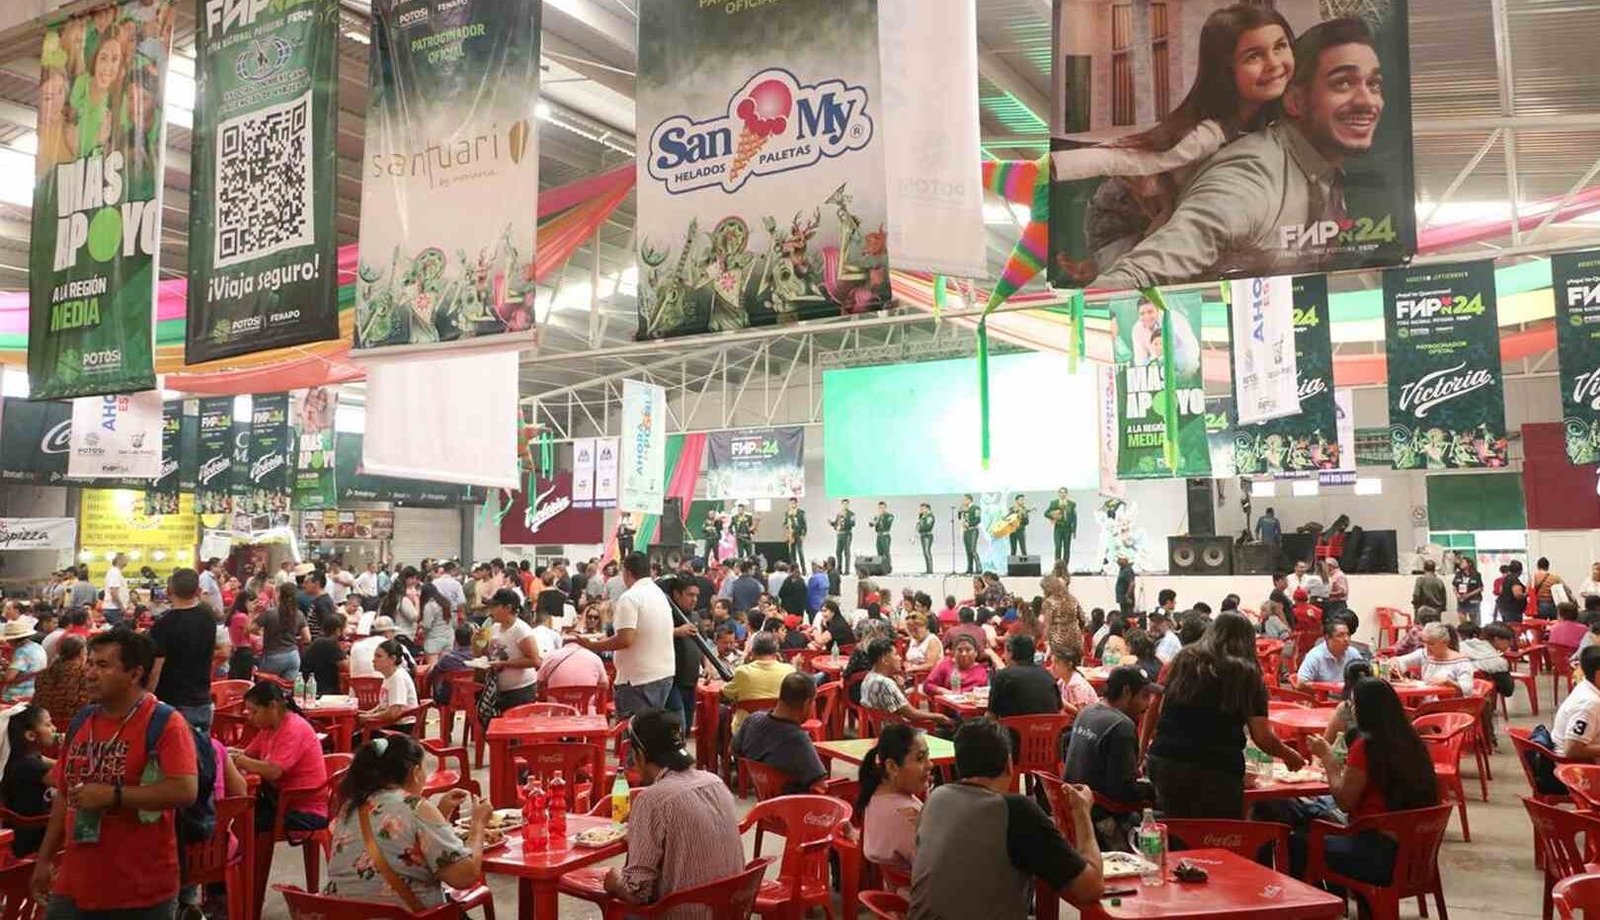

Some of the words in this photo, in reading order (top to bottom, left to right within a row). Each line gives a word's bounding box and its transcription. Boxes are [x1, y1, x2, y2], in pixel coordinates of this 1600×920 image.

[656, 126, 733, 170] San
[796, 92, 856, 146] My
[759, 144, 812, 165] PALETAS
[674, 163, 727, 184] HELADOS
[69, 274, 107, 298] REGIÓN
[207, 271, 255, 303] ¡Viaja
[257, 253, 321, 291] seguro!
[1399, 361, 1492, 418] Victoria
[1573, 719, 1587, 736] 3
